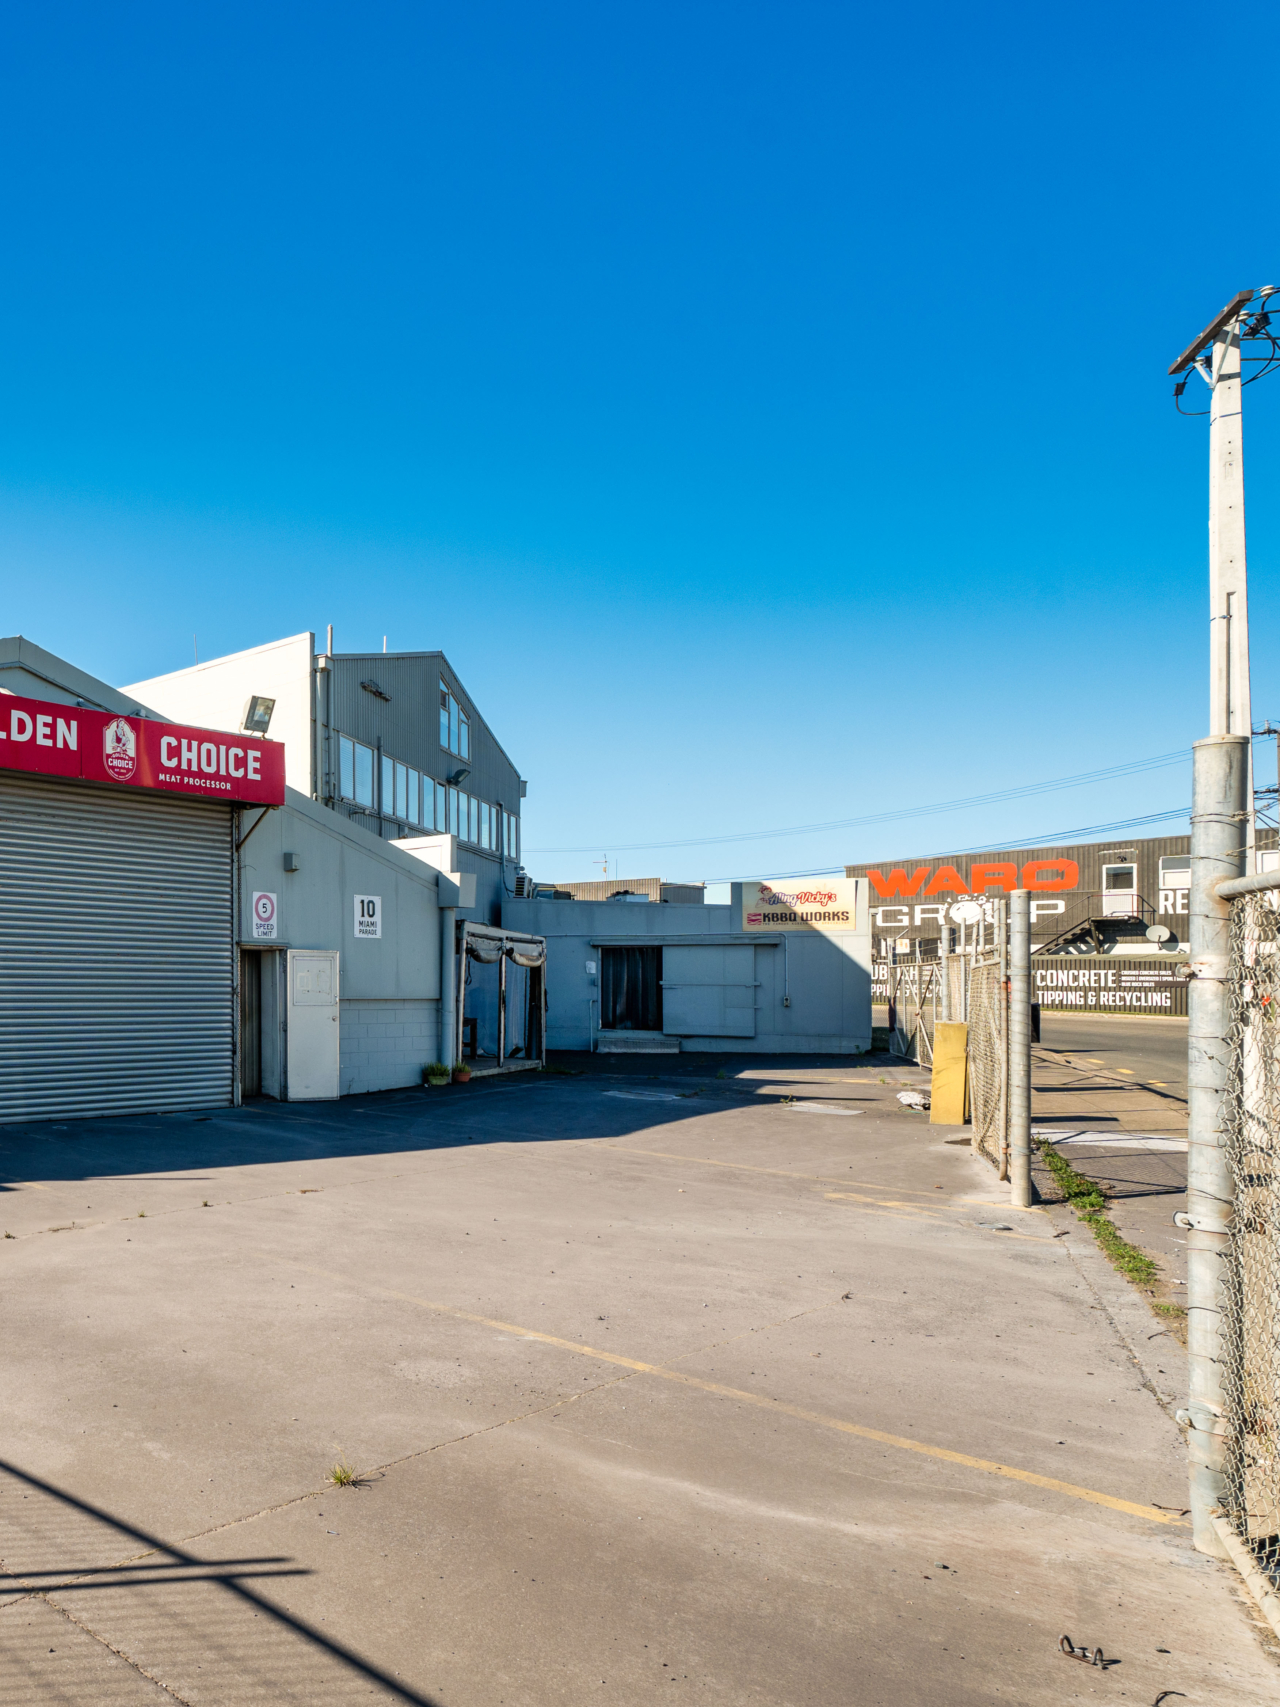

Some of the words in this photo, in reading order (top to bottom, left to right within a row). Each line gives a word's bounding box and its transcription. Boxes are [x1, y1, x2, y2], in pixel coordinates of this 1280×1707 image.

[108, 758, 133, 769] CHOICE
[160, 735, 261, 781] CHOICE
[158, 773, 181, 783] MEAT
[183, 777, 231, 790] PROCESSOR
[768, 892, 799, 907] Aling
[797, 891, 837, 907] Vicky's
[262, 903, 267, 913] 5
[360, 899, 375, 918] 10
[358, 920, 377, 928] MIAMI
[762, 912, 797, 922] KBBQ
[800, 911, 850, 922] WORKS
[358, 928, 377, 936] PARADE
[1037, 970, 1116, 987] CONCRETE
[1037, 991, 1084, 1005] TIPPING
[1088, 992, 1097, 1005] &
[1100, 991, 1171, 1007] RECYCLING
